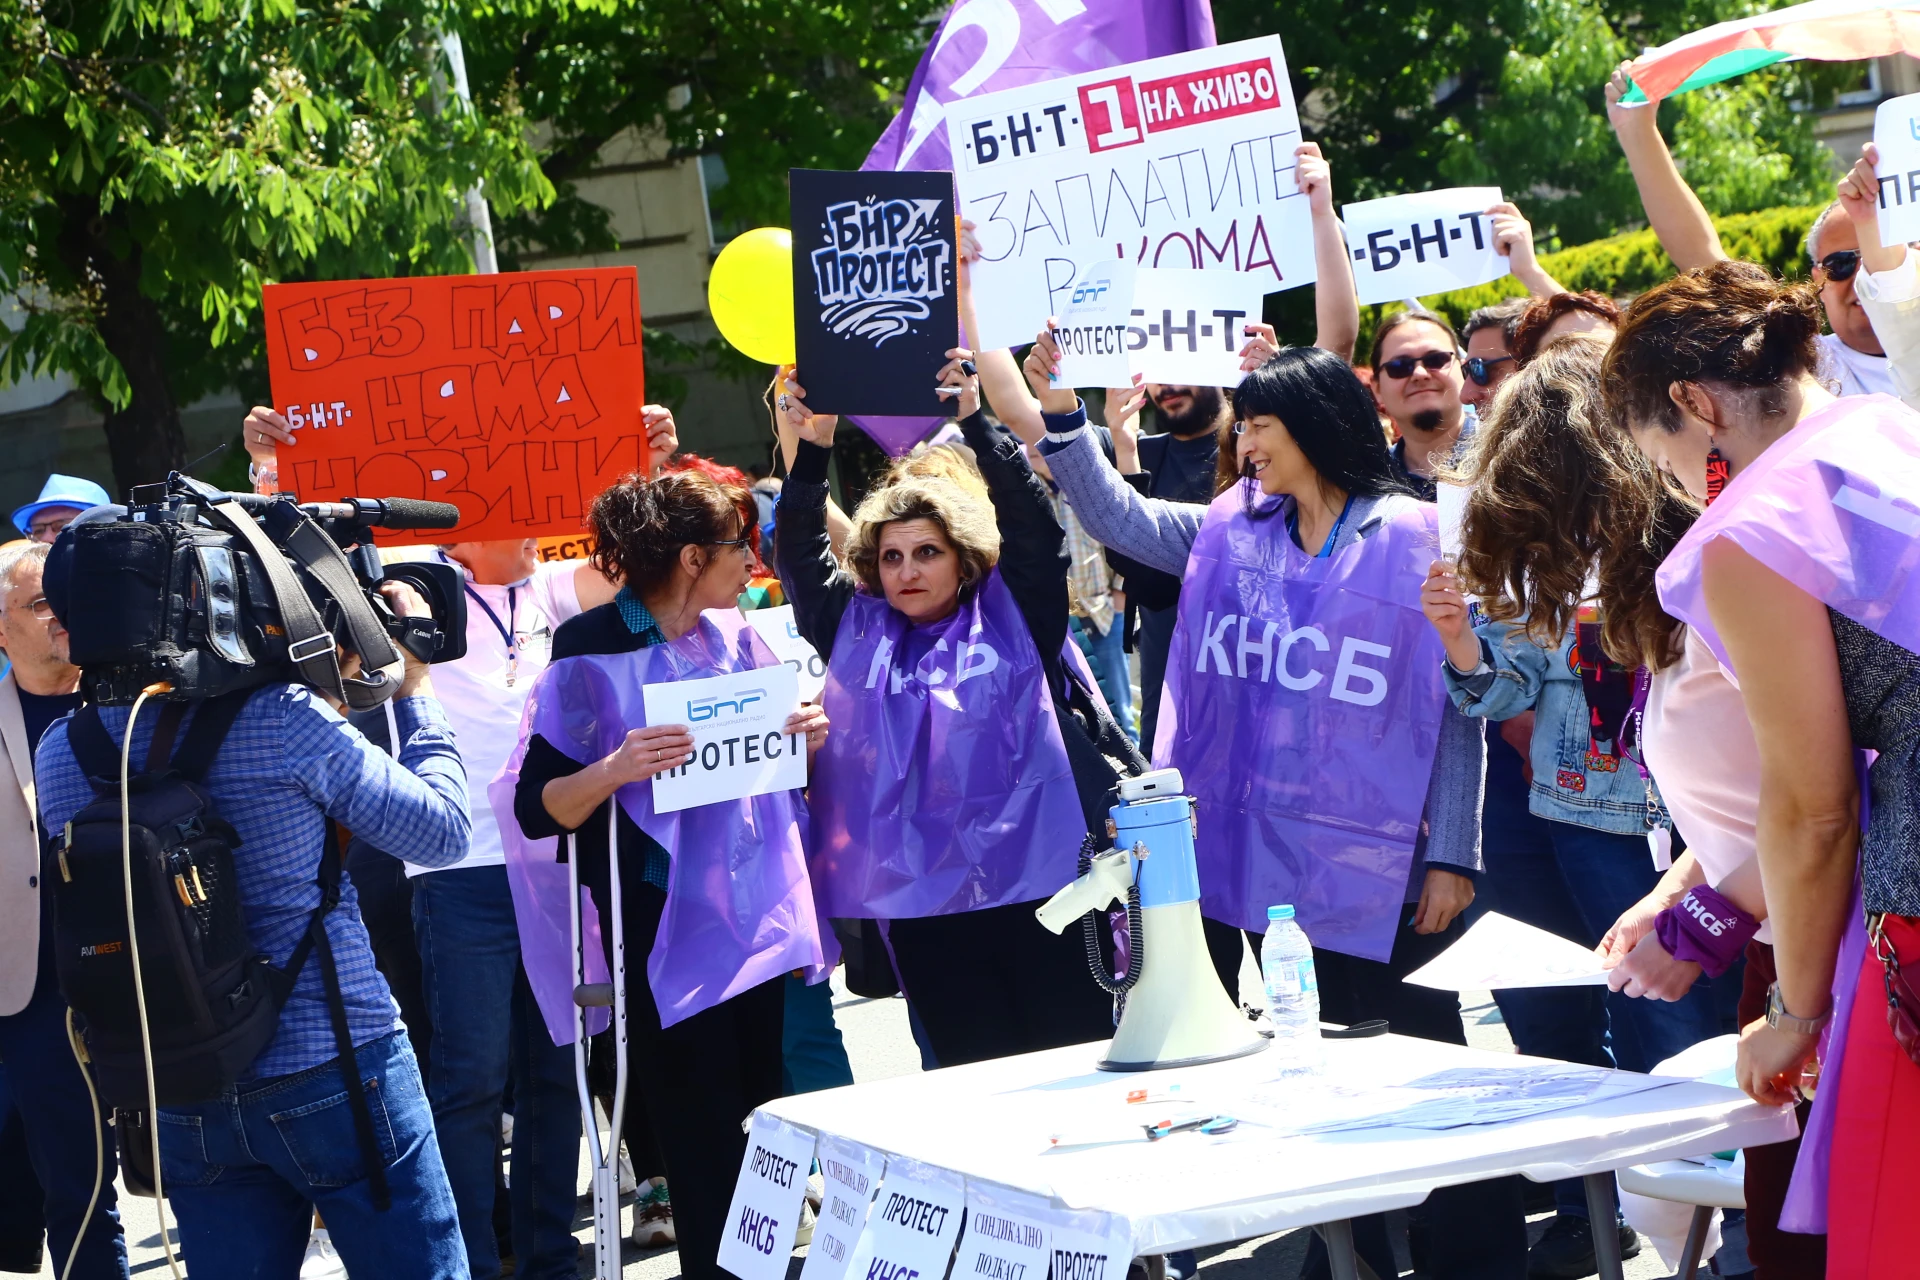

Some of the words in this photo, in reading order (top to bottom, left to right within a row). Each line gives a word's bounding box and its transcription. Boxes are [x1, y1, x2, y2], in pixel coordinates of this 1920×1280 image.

[1142, 87, 1186, 124] НА
[1188, 67, 1275, 114] ЖИВО
[970, 130, 1303, 261] ЗАПЛАТИТЕ
[826, 199, 916, 252] БНР
[811, 239, 950, 305] ПРОТЕСТ
[279, 287, 424, 371] БЕЗ
[452, 278, 637, 359] ПАРИ
[1052, 325, 1126, 356] ПРОТЕСТ
[366, 354, 600, 445] НЯМА
[413, 628, 431, 639] Canon
[1196, 611, 1391, 706] КНСБ
[1681, 892, 1727, 937] КНСБ
[81, 942, 122, 957] AVIWEST
[750, 1145, 798, 1189] ПРОТЕСТ
[827, 1159, 869, 1196] СИНДИКАЛНО
[737, 1205, 779, 1255] КНСБ
[831, 1195, 857, 1227] ПОДКАСТ
[882, 1192, 949, 1237] ПРОТЕСТ
[974, 1212, 1043, 1250] СИНДИКАЛНО
[822, 1232, 846, 1263] СТУДИО
[975, 1252, 1027, 1280] ПОДКАСТ
[1054, 1249, 1108, 1280] ПРОТЕСТ
